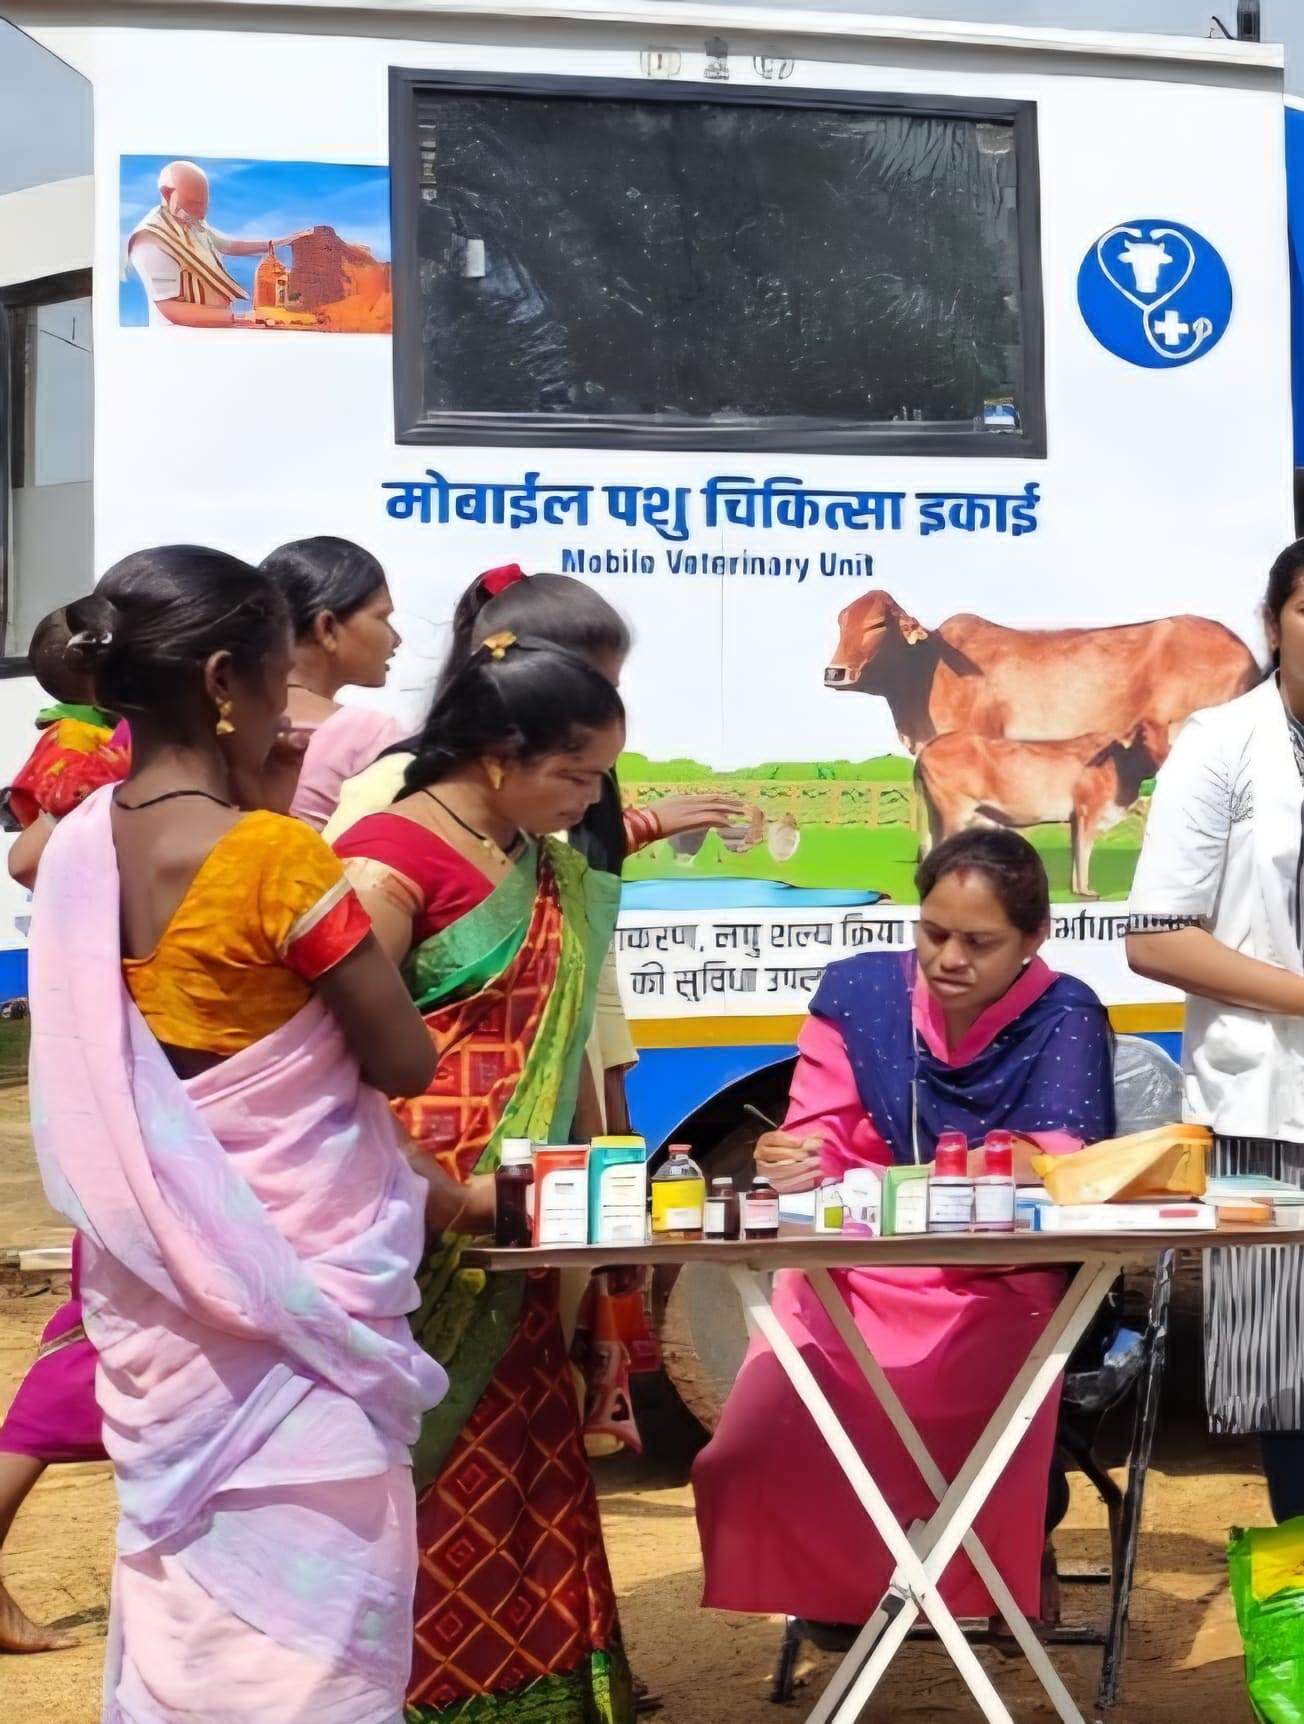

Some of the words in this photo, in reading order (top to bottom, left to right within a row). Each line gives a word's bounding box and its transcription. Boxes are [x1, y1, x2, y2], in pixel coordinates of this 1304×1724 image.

[381, 468, 594, 529] मोबाईल
[602, 486, 691, 541] पशु
[700, 476, 906, 531] चिकित्सा
[915, 482, 1041, 536] इकाई
[562, 549, 655, 575] Mobile
[667, 549, 809, 583] Veterinary
[820, 552, 874, 577] Unit
